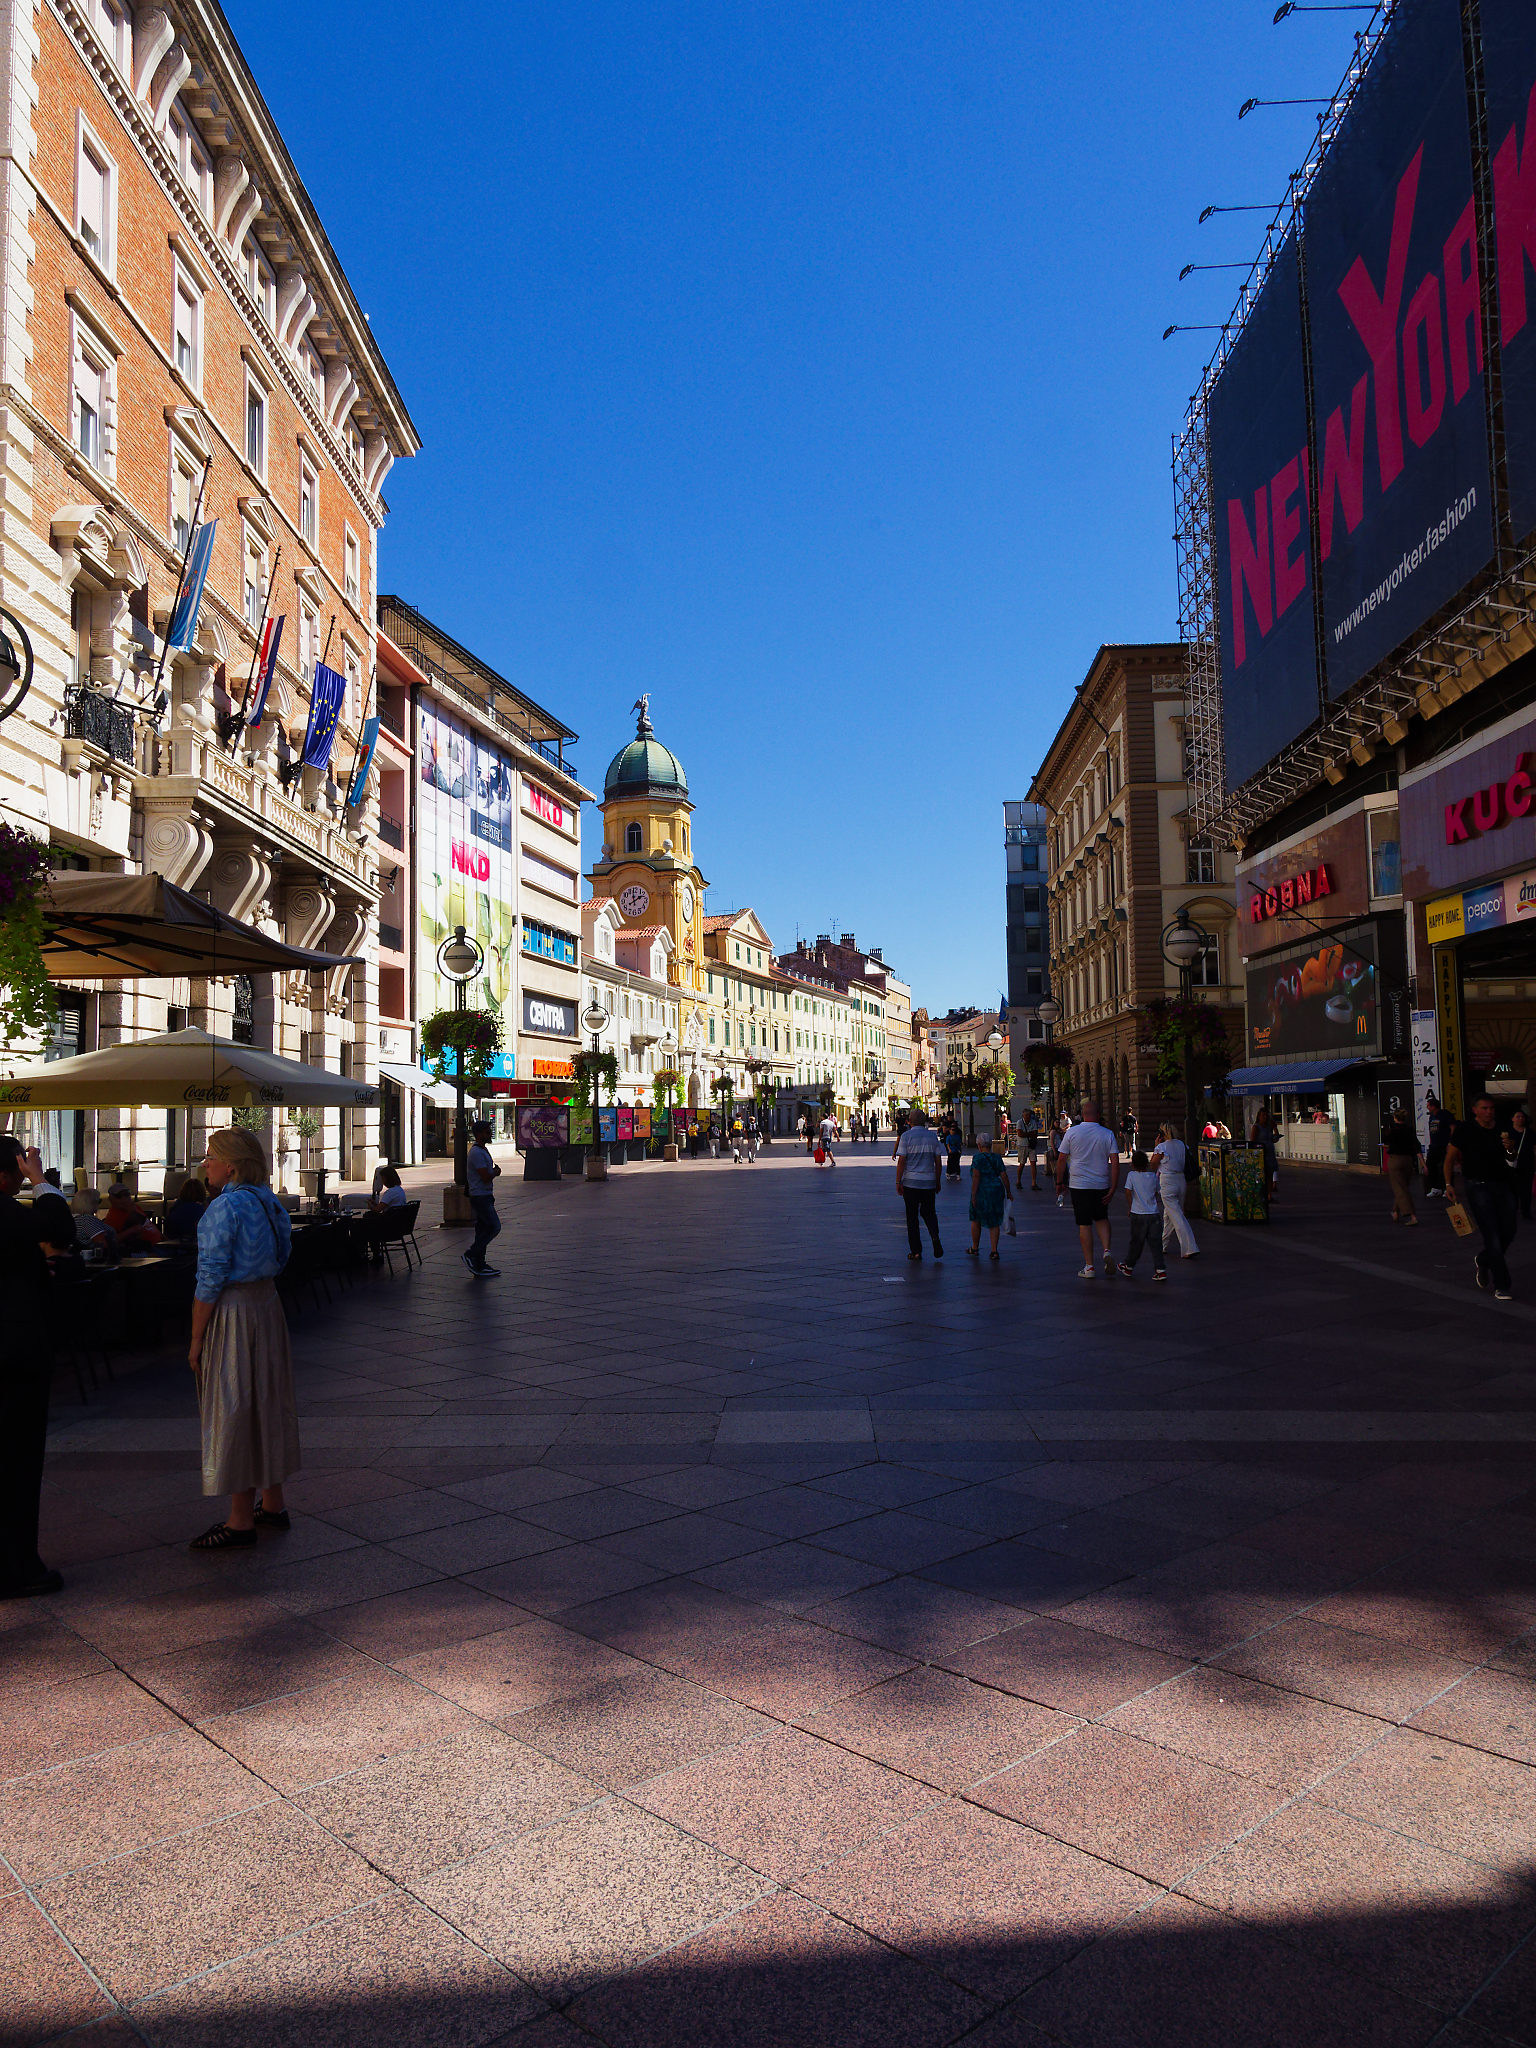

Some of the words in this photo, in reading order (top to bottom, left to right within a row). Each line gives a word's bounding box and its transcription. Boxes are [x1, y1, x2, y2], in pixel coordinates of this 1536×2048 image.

[1334, 486, 1477, 644] www.newyorker.fashion
[530, 783, 563, 827] NKD
[452, 836, 490, 882] NKD
[1250, 864, 1334, 924] ROBNA
[1467, 898, 1500, 922] pepco
[1429, 913, 1445, 929] HAPPY
[1442, 955, 1451, 1018] HAPPY
[530, 1000, 565, 1030] CENTRA
[1394, 1003, 1403, 1045] europlakat
[1446, 1027, 1455, 1077] HOME
